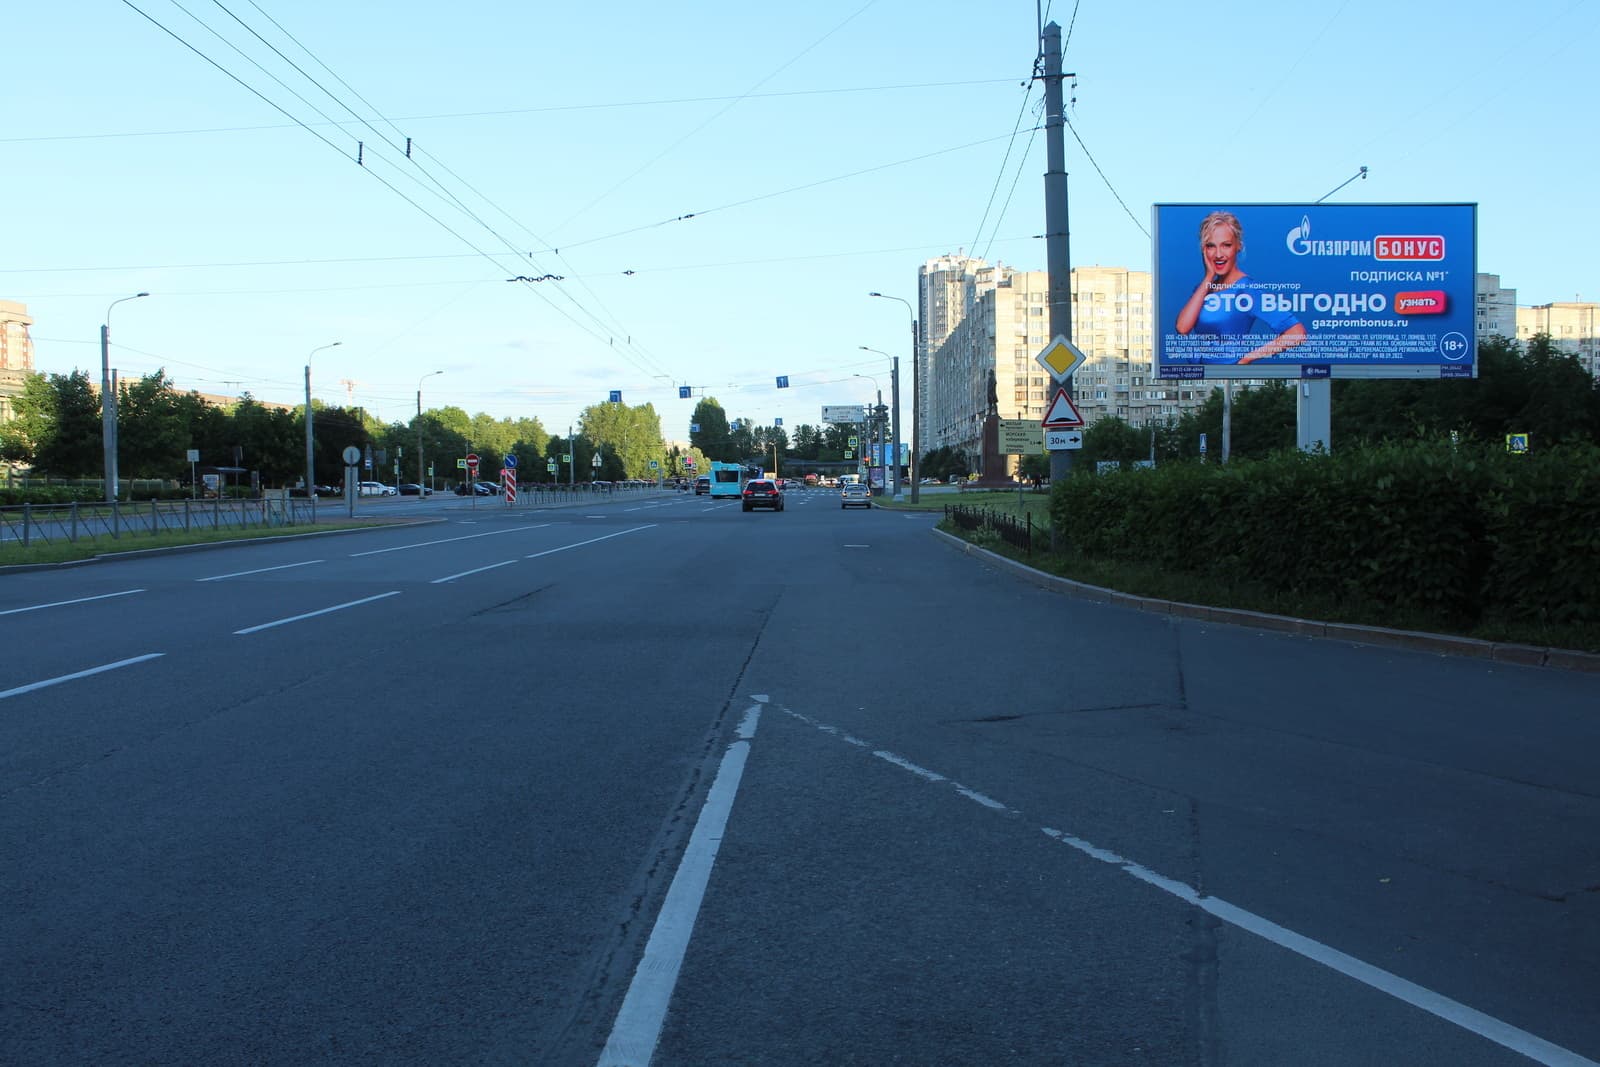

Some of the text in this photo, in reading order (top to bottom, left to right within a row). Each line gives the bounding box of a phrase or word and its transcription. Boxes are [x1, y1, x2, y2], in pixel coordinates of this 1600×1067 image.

[1312, 240, 1440, 256] ГАЗПРОМ БОНУС
[1350, 271, 1423, 283] ПОДПИСКА
[1205, 282, 1301, 291] Подписка-конструктор
[1203, 293, 1386, 316] ЭТО ВЫГОДНО
[1400, 298, 1436, 310] узнать
[1312, 317, 1409, 331] gazprombonus.ru
[1444, 340, 1463, 351] 18+
